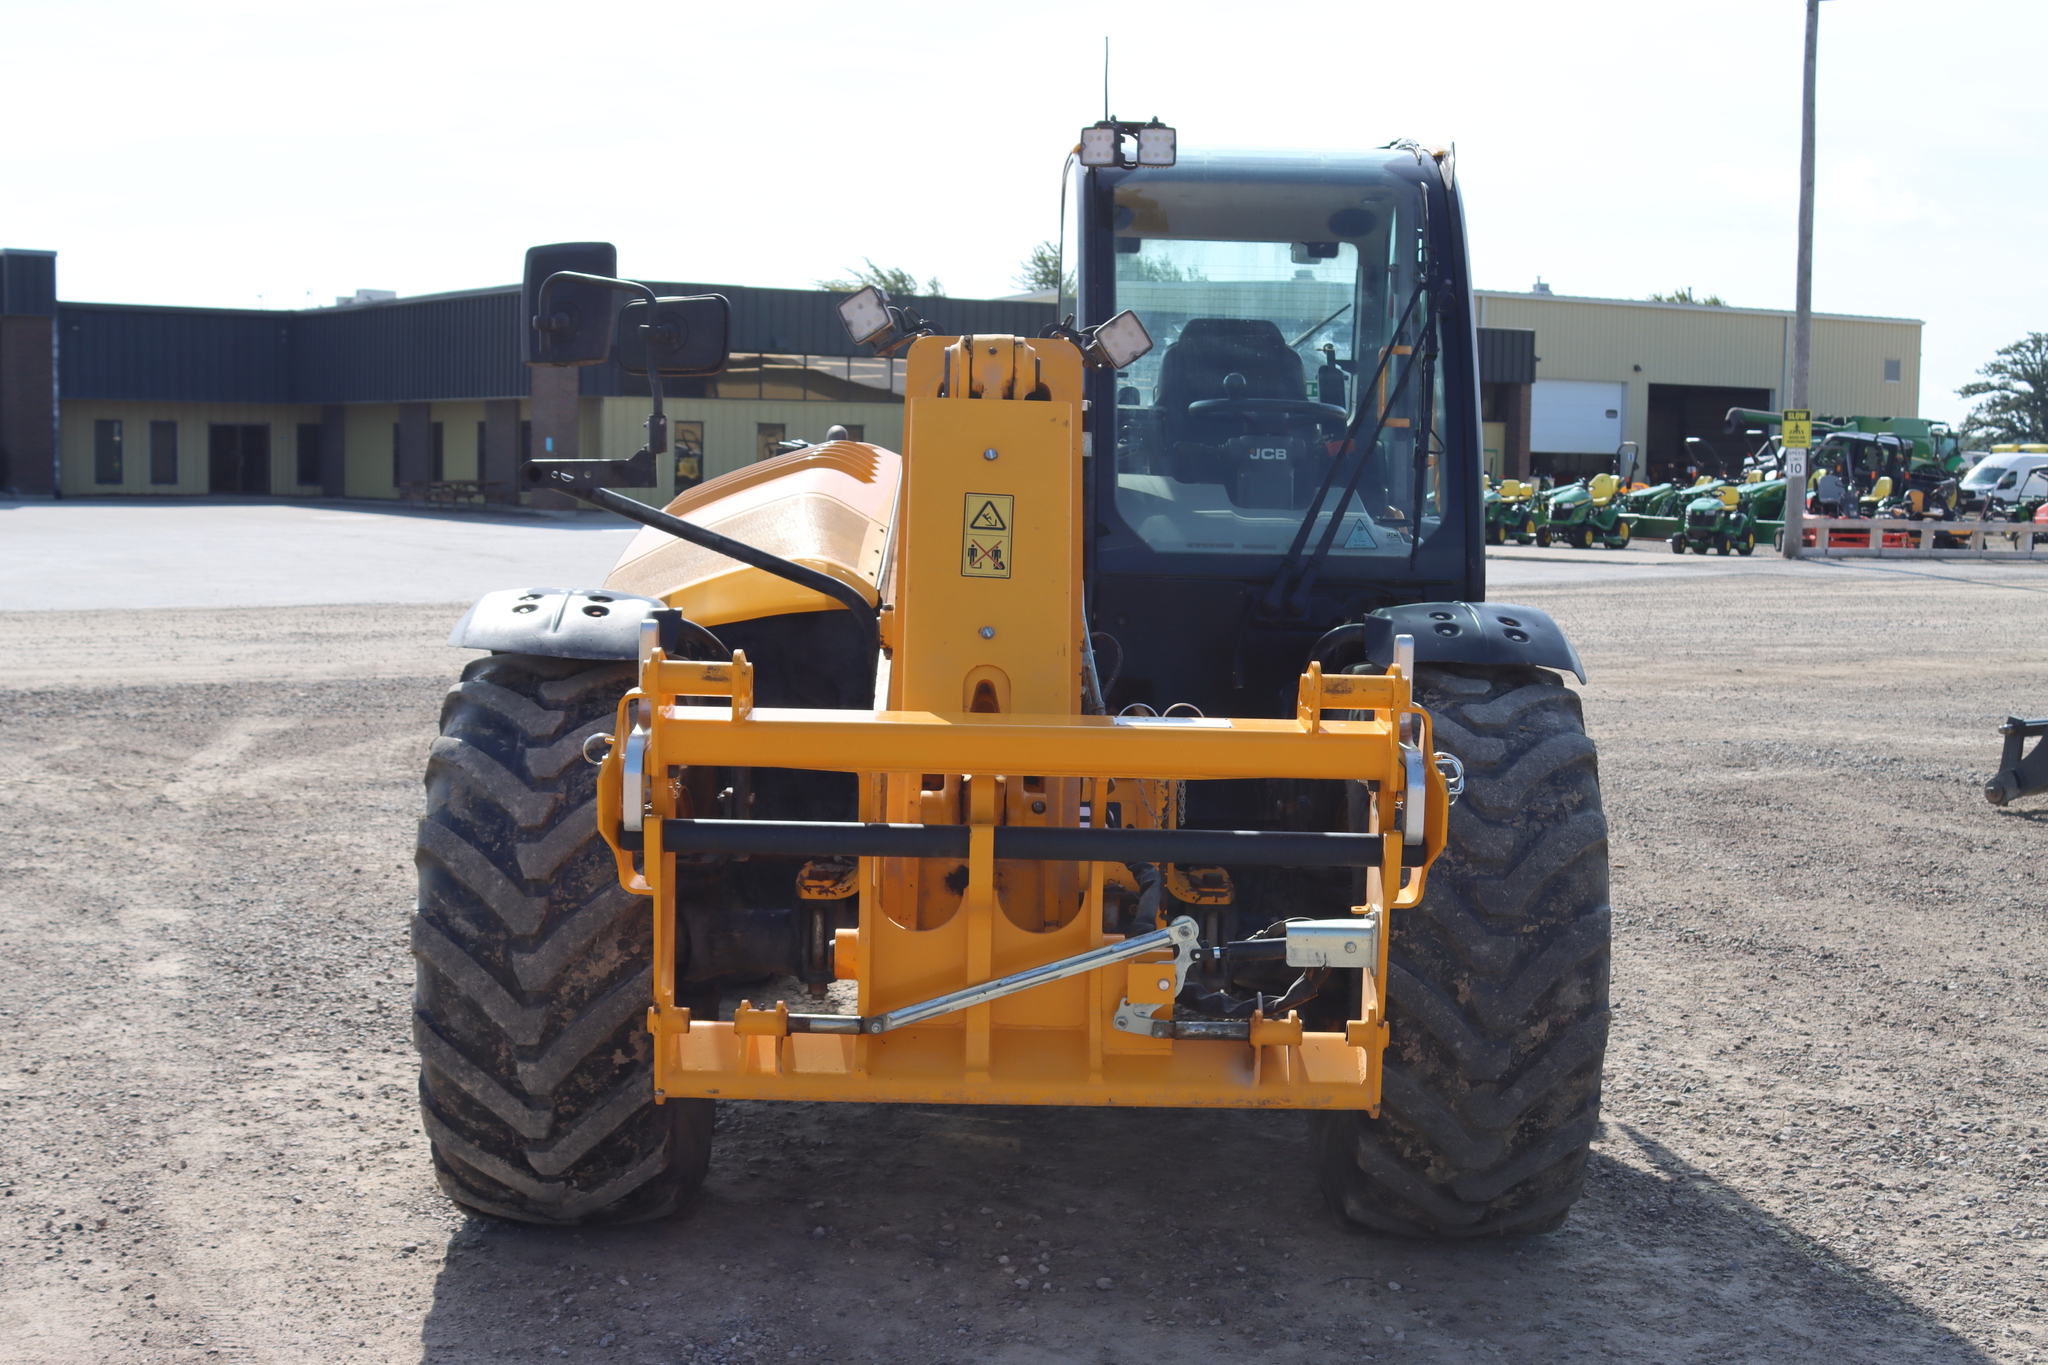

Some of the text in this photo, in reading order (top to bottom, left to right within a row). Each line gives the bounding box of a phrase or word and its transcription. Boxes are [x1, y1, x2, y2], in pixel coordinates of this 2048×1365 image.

[1787, 412, 1807, 420] SLOW
[1250, 448, 1287, 460] JCB
[1790, 463, 1802, 474] 10
